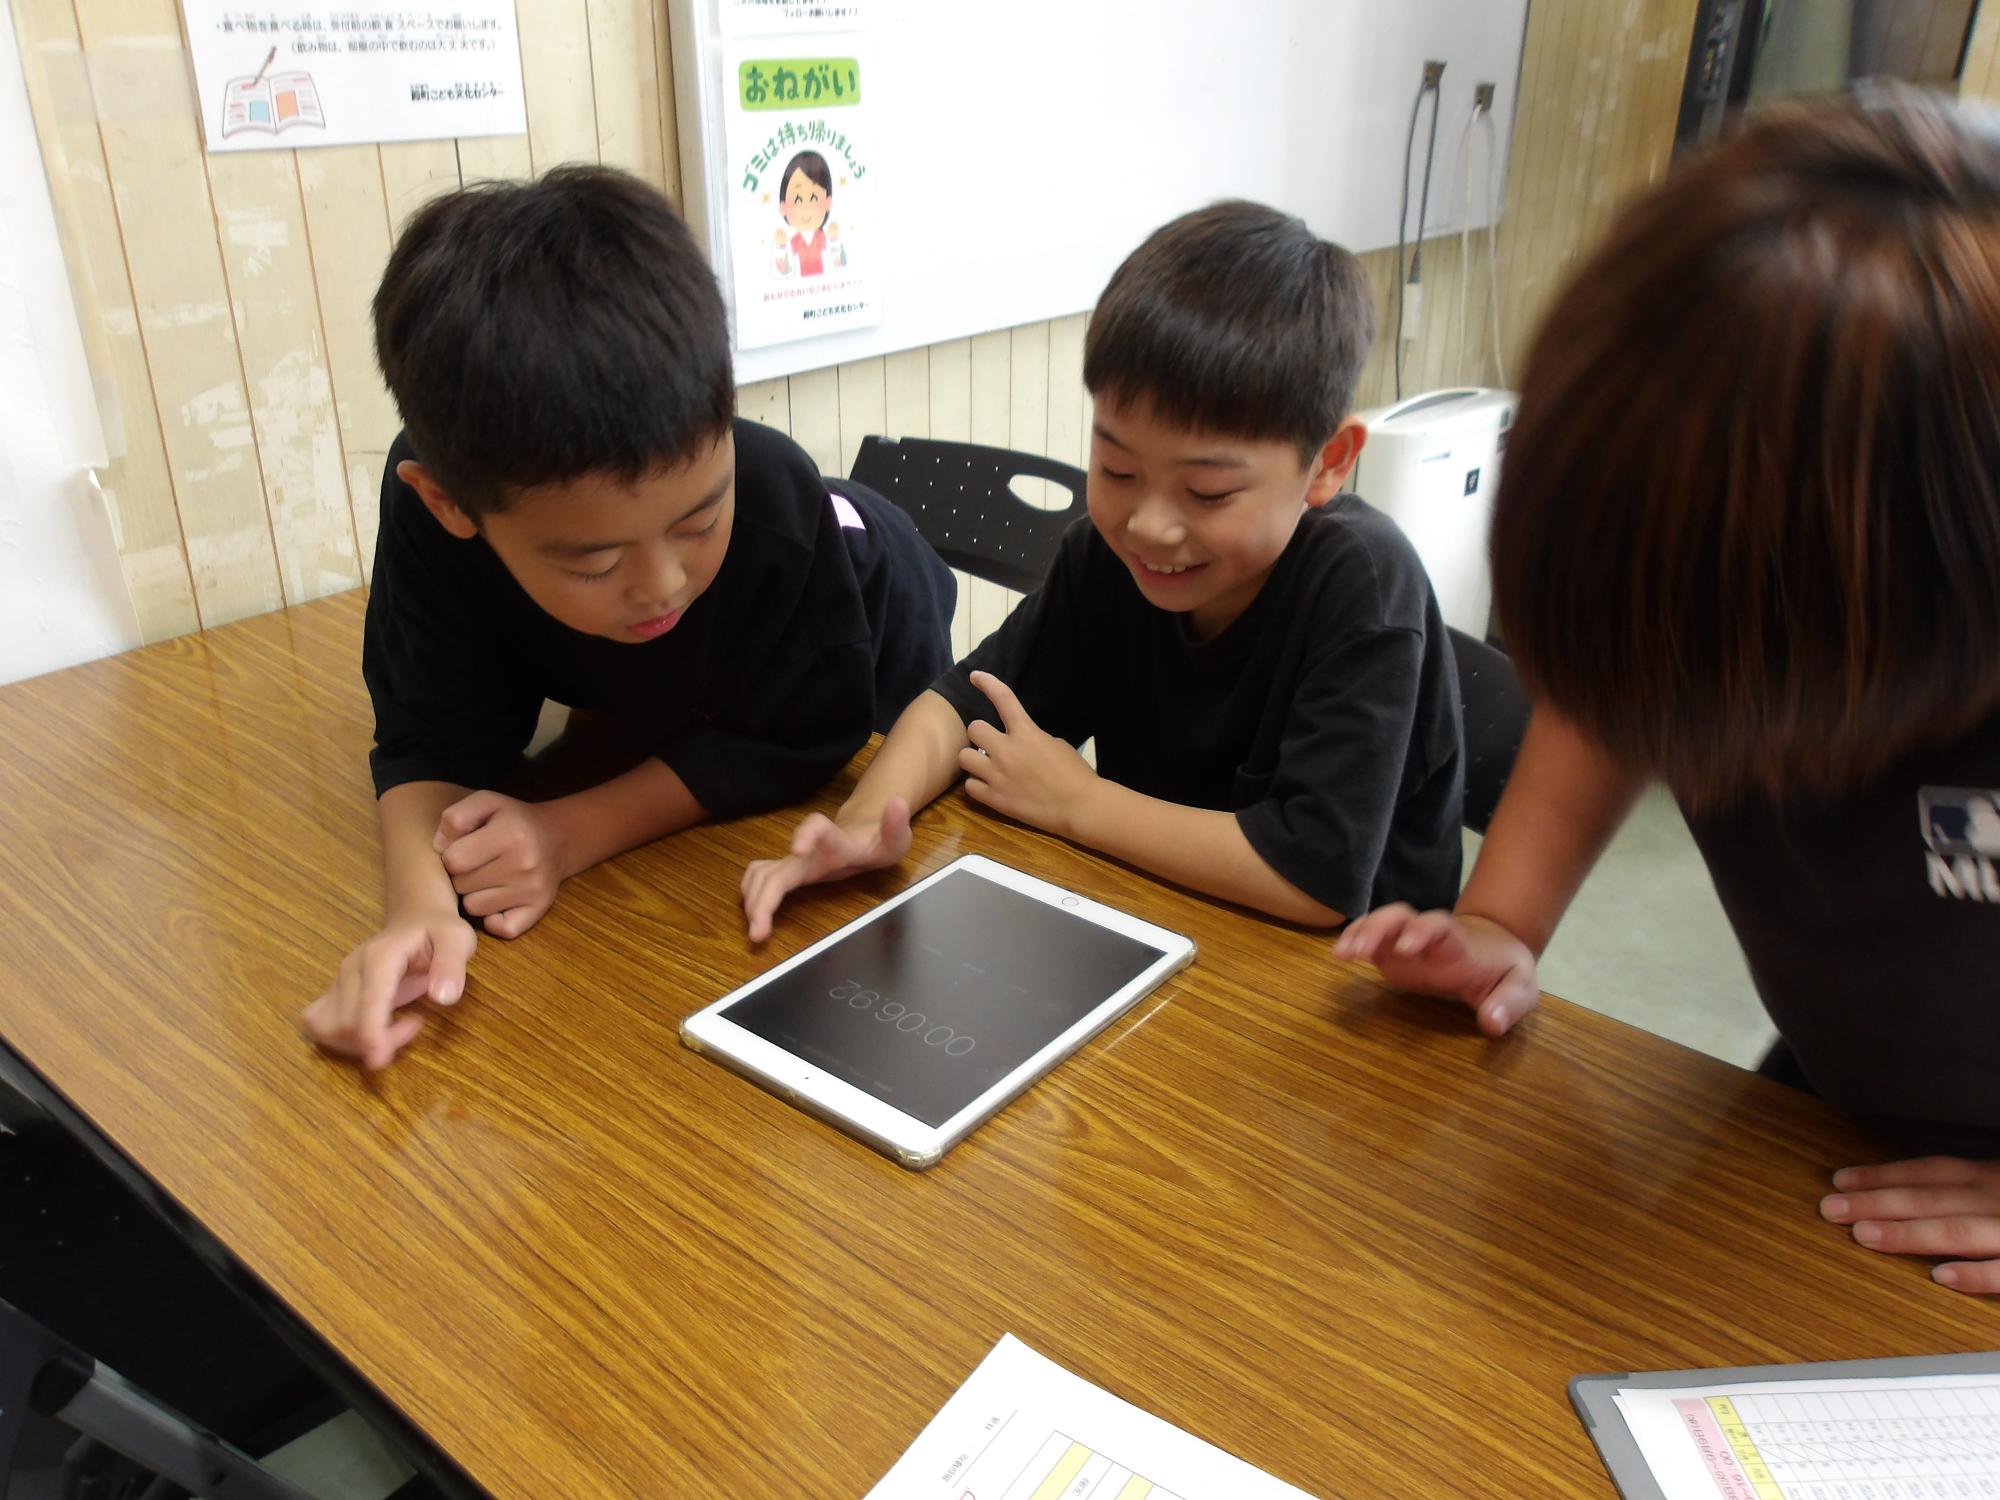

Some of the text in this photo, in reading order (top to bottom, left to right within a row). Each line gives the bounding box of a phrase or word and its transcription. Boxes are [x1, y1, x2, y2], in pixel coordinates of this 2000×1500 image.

[746, 64, 856, 103] おねがい
[743, 119, 866, 192] ゴミは持ち帰りましょう
